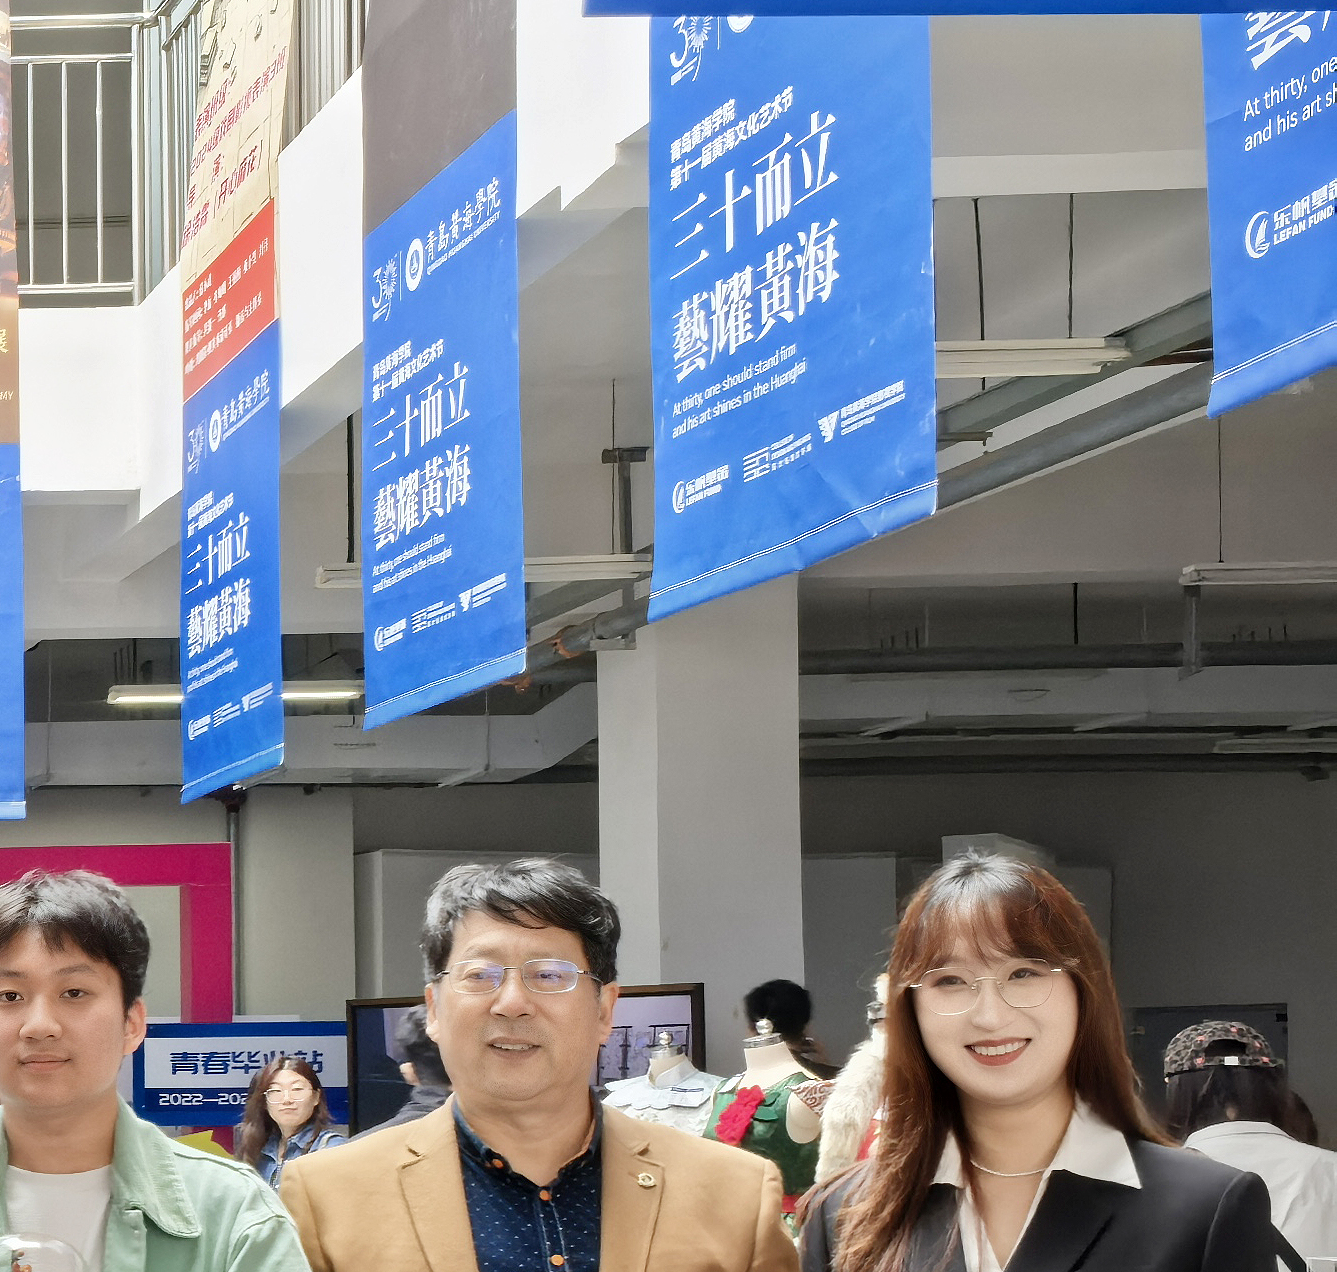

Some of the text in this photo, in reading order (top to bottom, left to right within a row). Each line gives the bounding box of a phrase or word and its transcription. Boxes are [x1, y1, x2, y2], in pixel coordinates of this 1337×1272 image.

[1244, 56, 1337, 122] At thirty, one
[1244, 94, 1322, 152] and his art
[670, 110, 839, 281] 三十而立
[1274, 204, 1334, 245] LEFAN FUND
[372, 361, 470, 471] 三十而立
[185, 510, 251, 595] 三十而立
